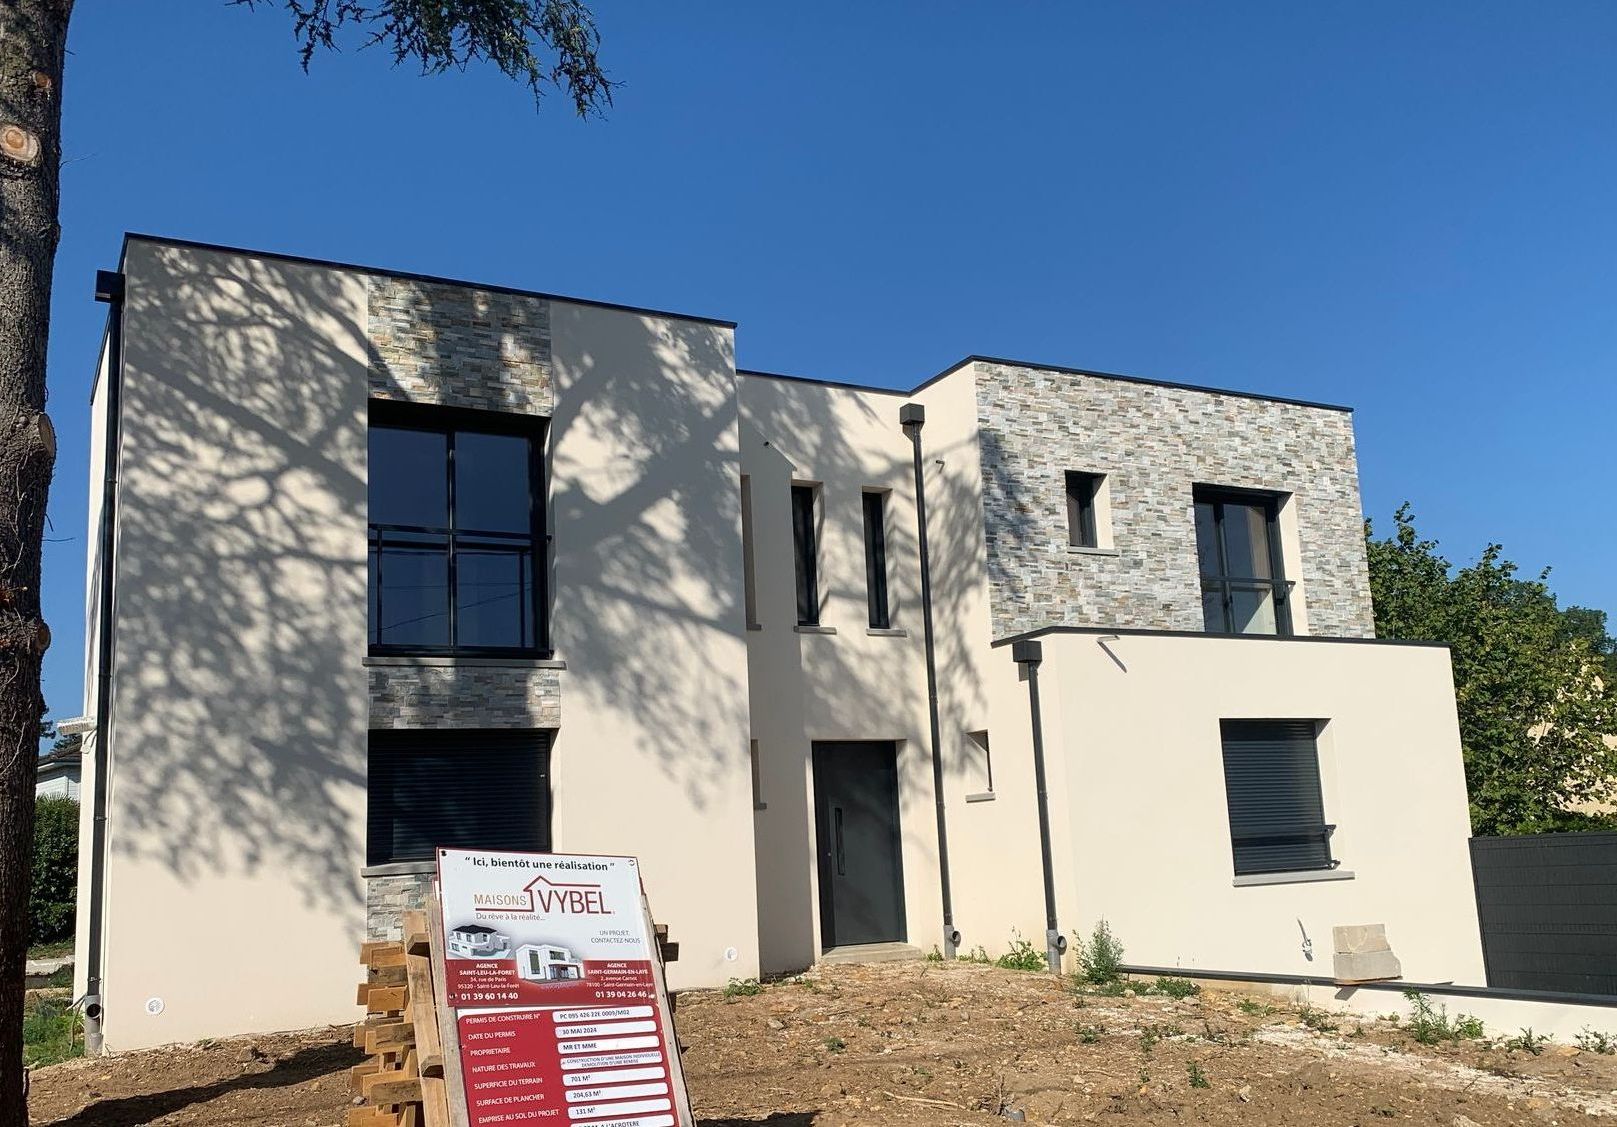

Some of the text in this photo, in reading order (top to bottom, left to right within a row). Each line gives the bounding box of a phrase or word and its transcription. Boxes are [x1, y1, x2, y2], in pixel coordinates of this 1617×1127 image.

[473, 857, 488, 868] Ici,
[492, 858, 530, 868] bientôt
[555, 860, 608, 871] réalisation
[474, 890, 611, 914] MAISONS VYBEL
[498, 1014, 533, 1022] CONSTRUIRE
[470, 1047, 510, 1056] PROPRIETAIRE
[472, 1065, 496, 1073] NATURE
[475, 1081, 507, 1090] SUPERFICIE
[476, 1098, 503, 1107] SURFACE
[514, 1094, 544, 1102] PLANCHER
[479, 1115, 504, 1123] EMPRISE
